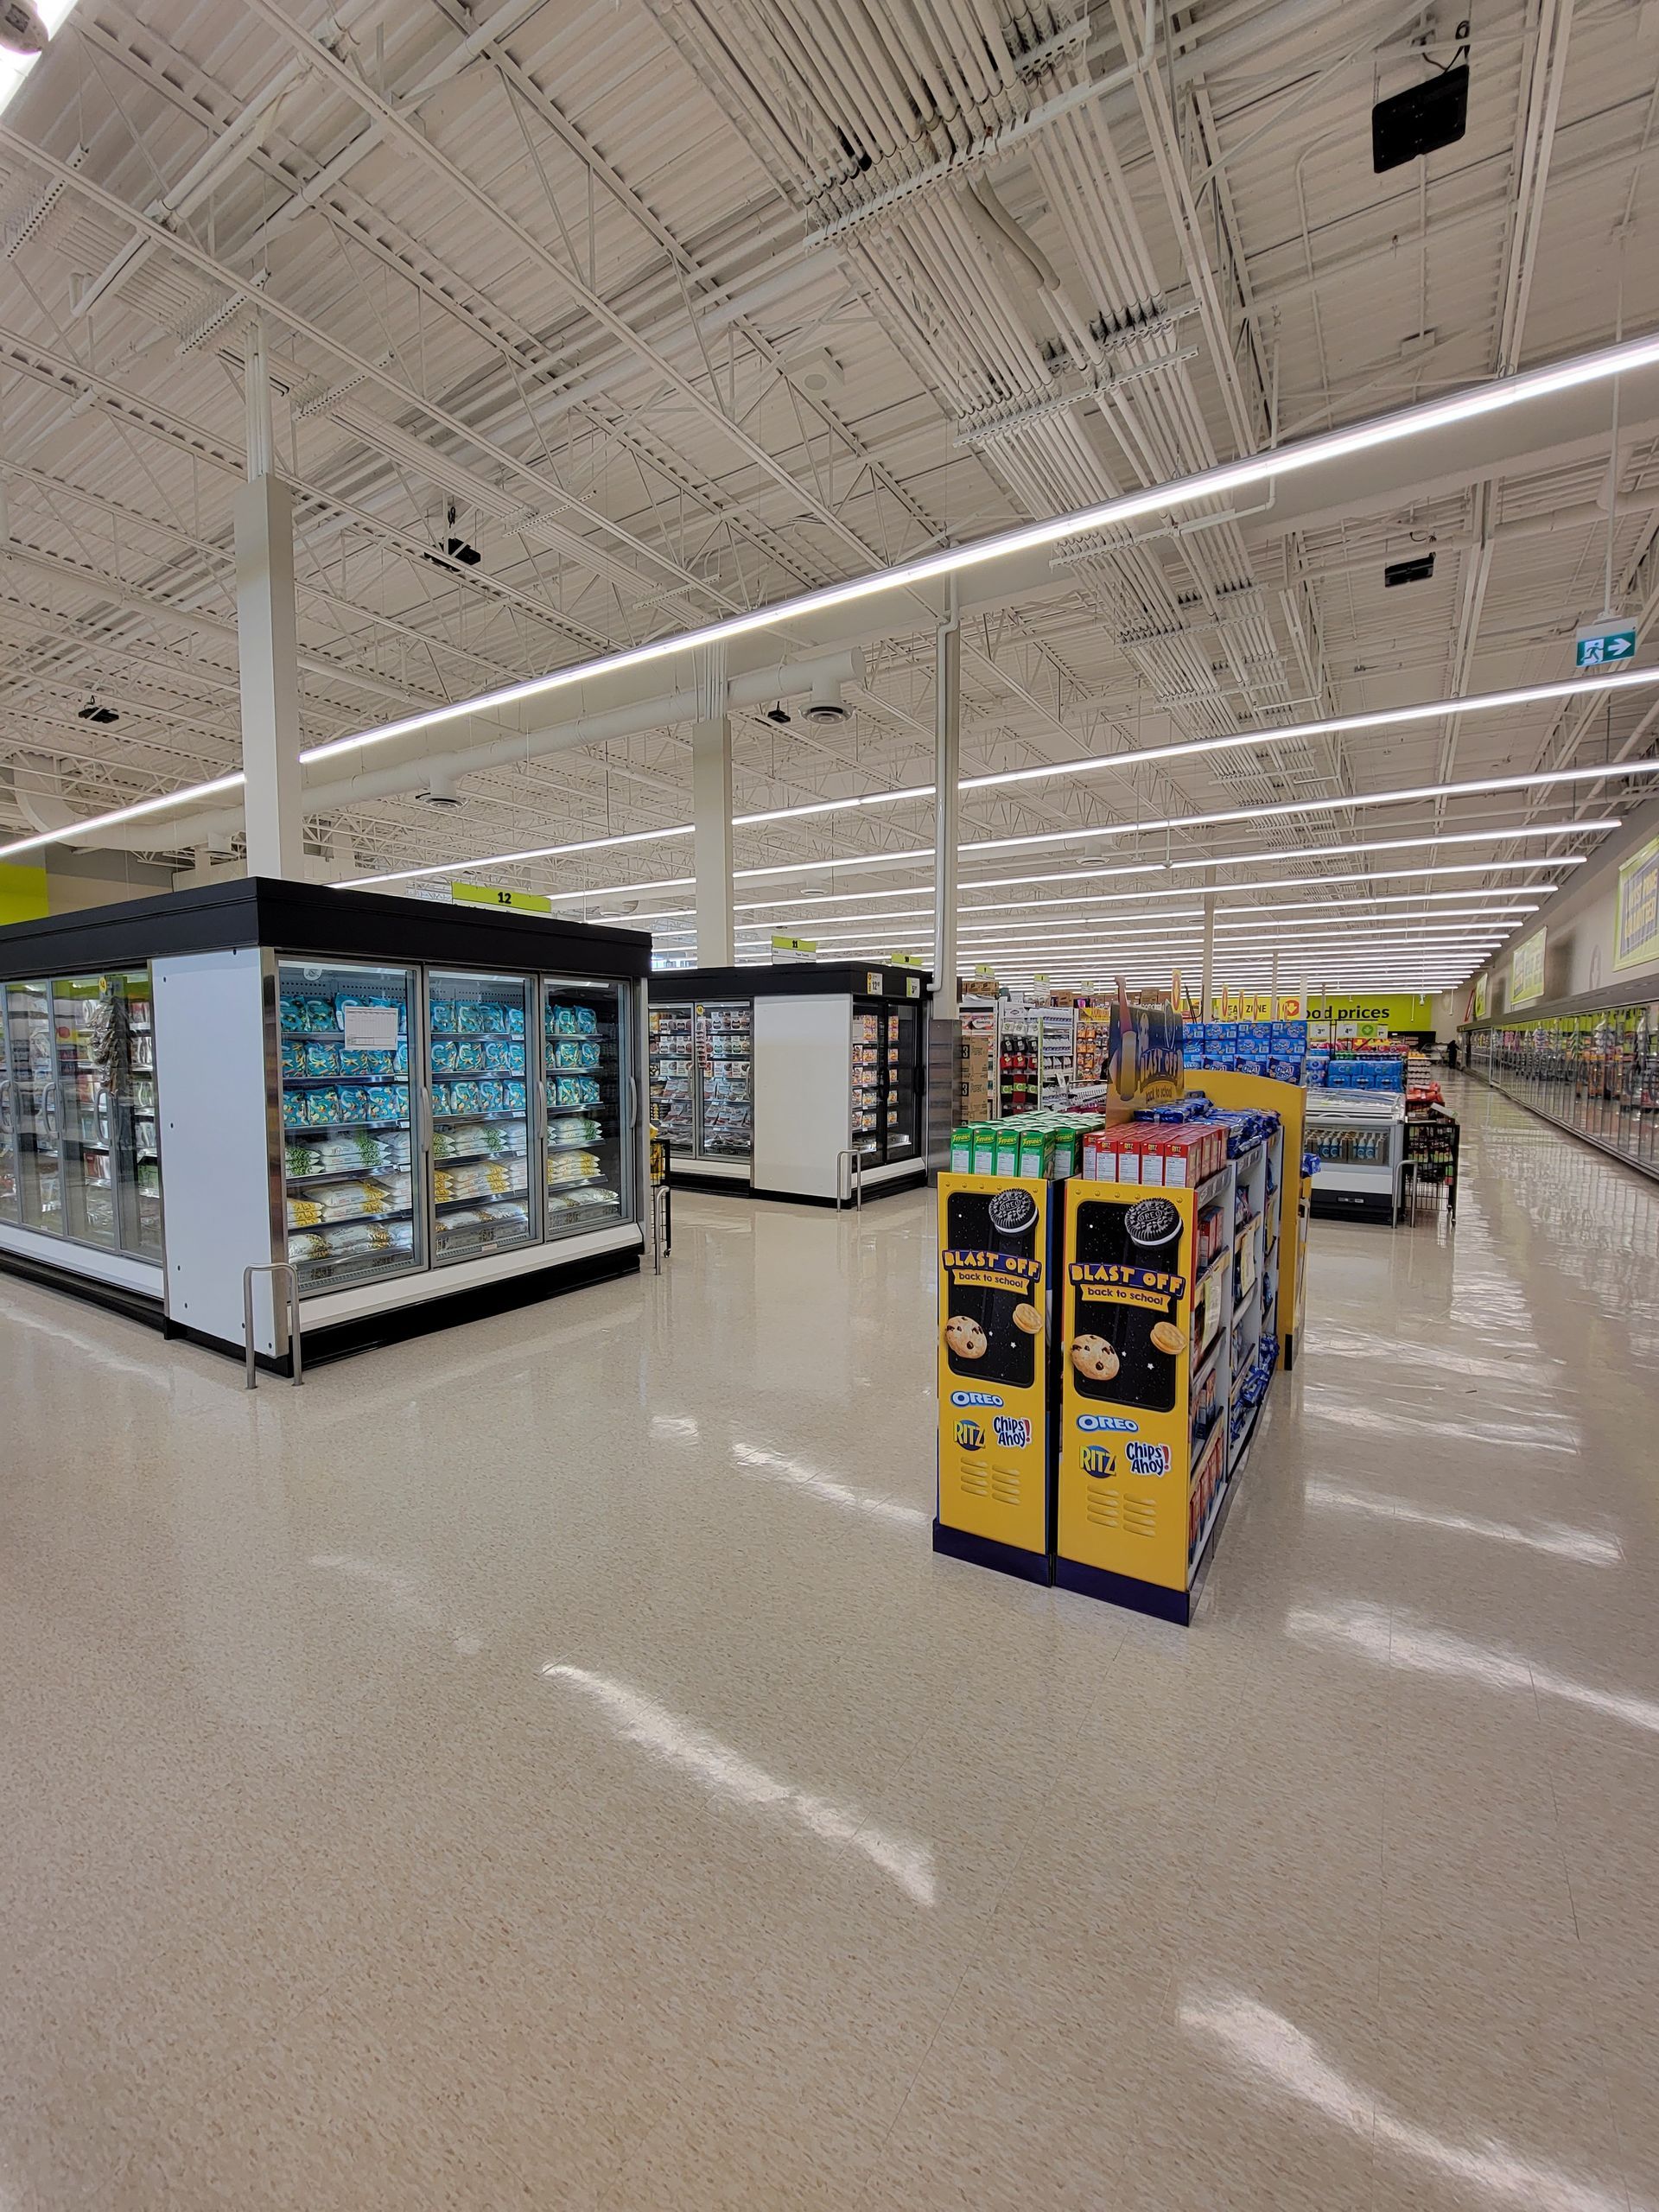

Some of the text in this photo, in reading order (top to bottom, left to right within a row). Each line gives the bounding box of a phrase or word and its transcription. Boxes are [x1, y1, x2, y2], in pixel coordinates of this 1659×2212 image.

[498, 892, 512, 904] 12
[1338, 1005, 1389, 1020] prices
[963, 1046, 968, 1058] 3
[962, 1084, 968, 1095] 3
[1001, 1198, 1022, 1210] OREO
[1138, 1211, 1162, 1222] OREO
[944, 1251, 1039, 1277] BLAST OFF
[959, 1272, 1023, 1288] back to school
[1071, 1264, 1183, 1294] BLAST OFF
[1087, 1287, 1163, 1306] back to school
[951, 1391, 1004, 1407] OREO
[994, 1416, 1024, 1433] Chips
[1077, 1414, 1138, 1432] OREO
[953, 1420, 986, 1448] RITZ
[1126, 1441, 1162, 1461] Chips
[1080, 1446, 1117, 1477] RITZ
